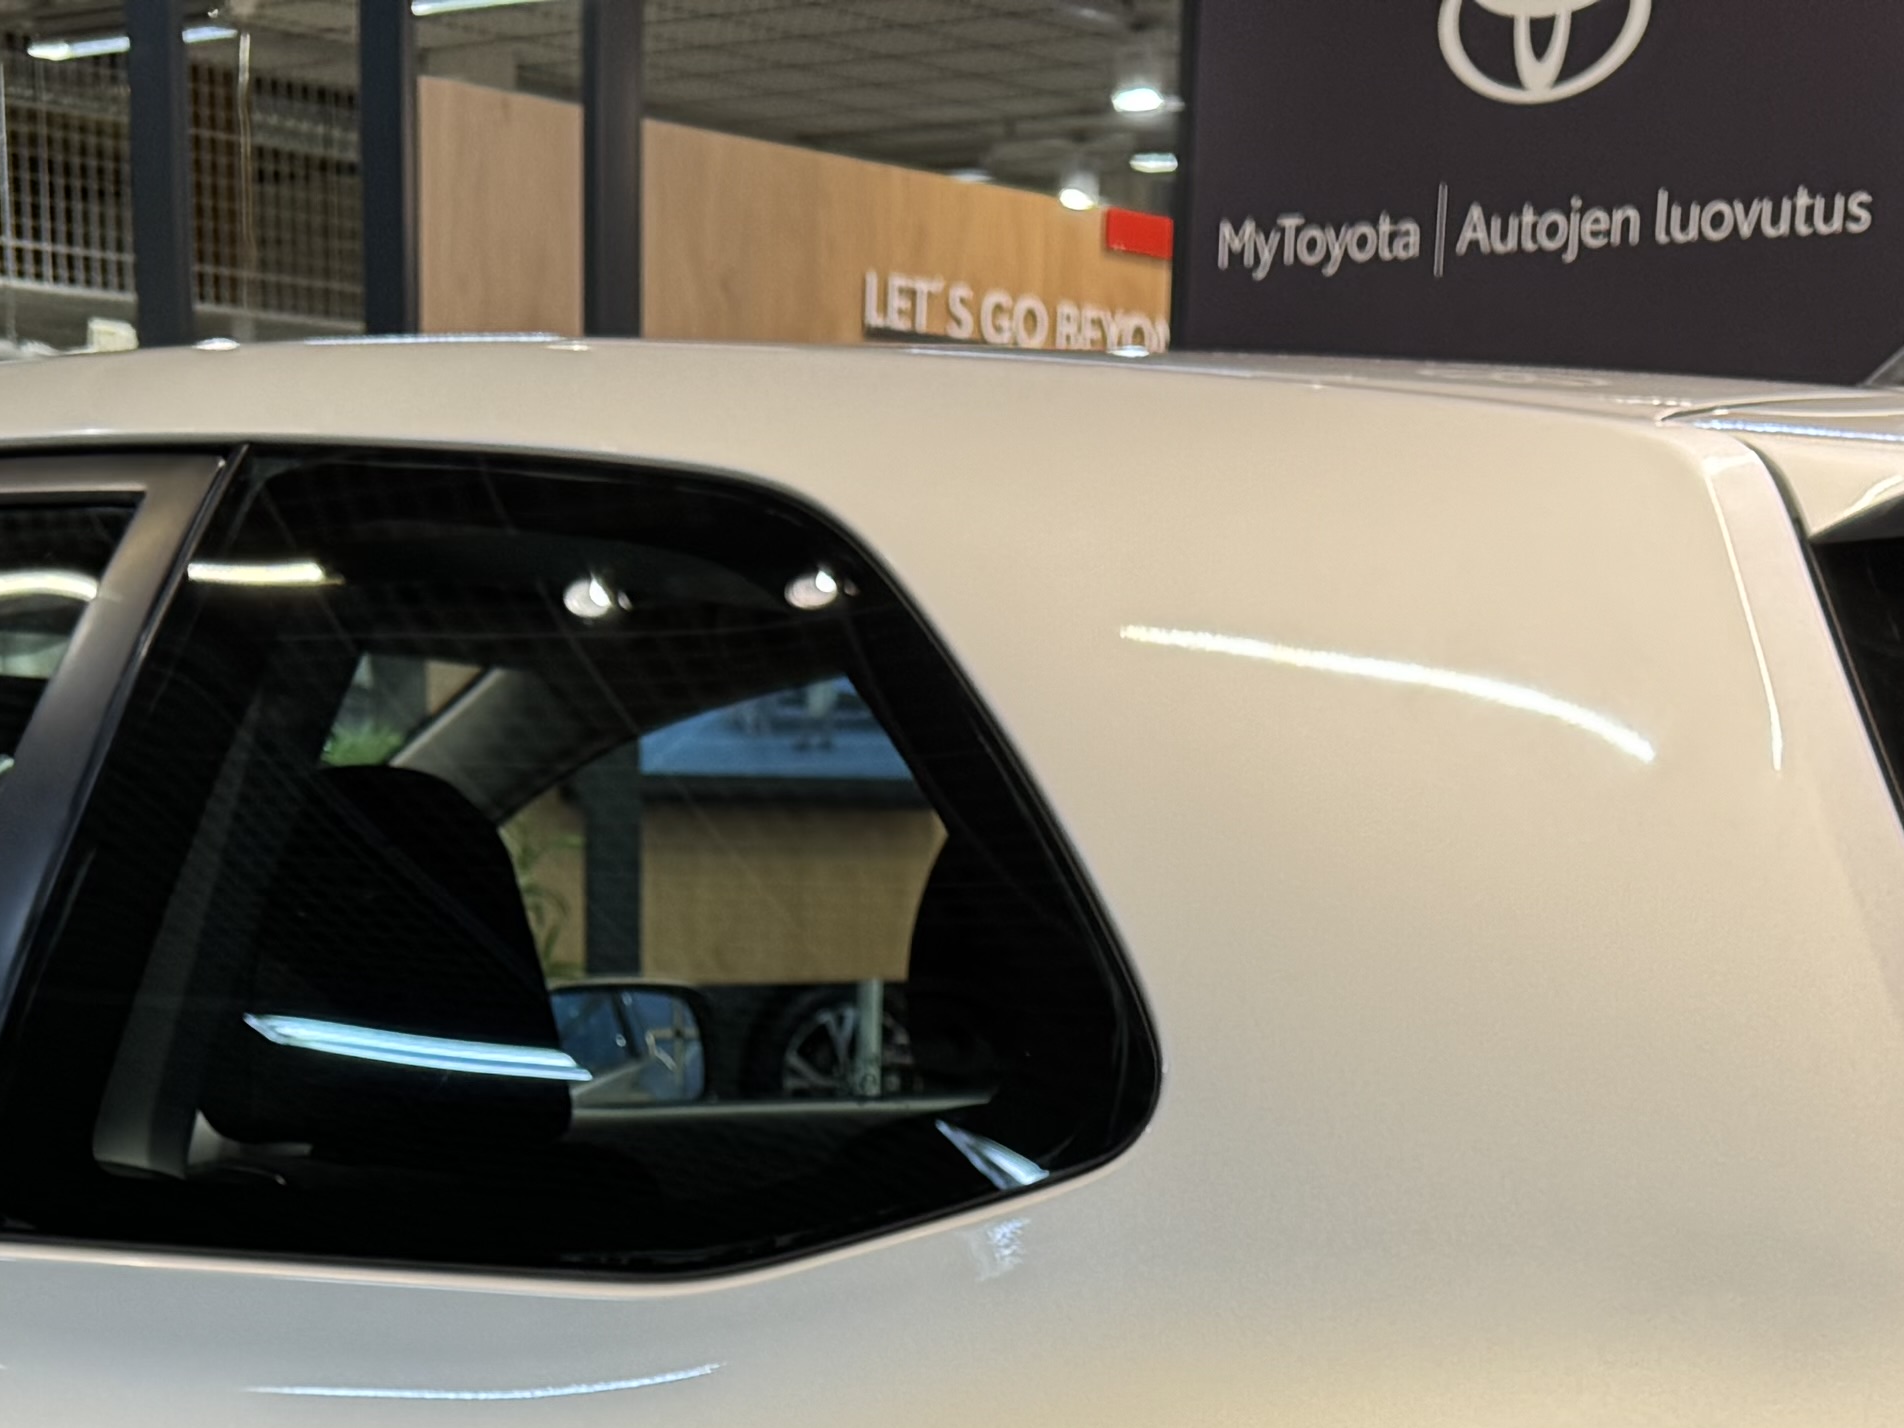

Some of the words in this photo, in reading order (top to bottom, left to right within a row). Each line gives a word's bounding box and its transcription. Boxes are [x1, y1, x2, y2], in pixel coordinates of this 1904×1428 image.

[1217, 209, 1421, 282] MyToyota
[1455, 194, 1641, 265] Autojen
[1653, 183, 1875, 246] luovutus
[979, 287, 1049, 349] GO
